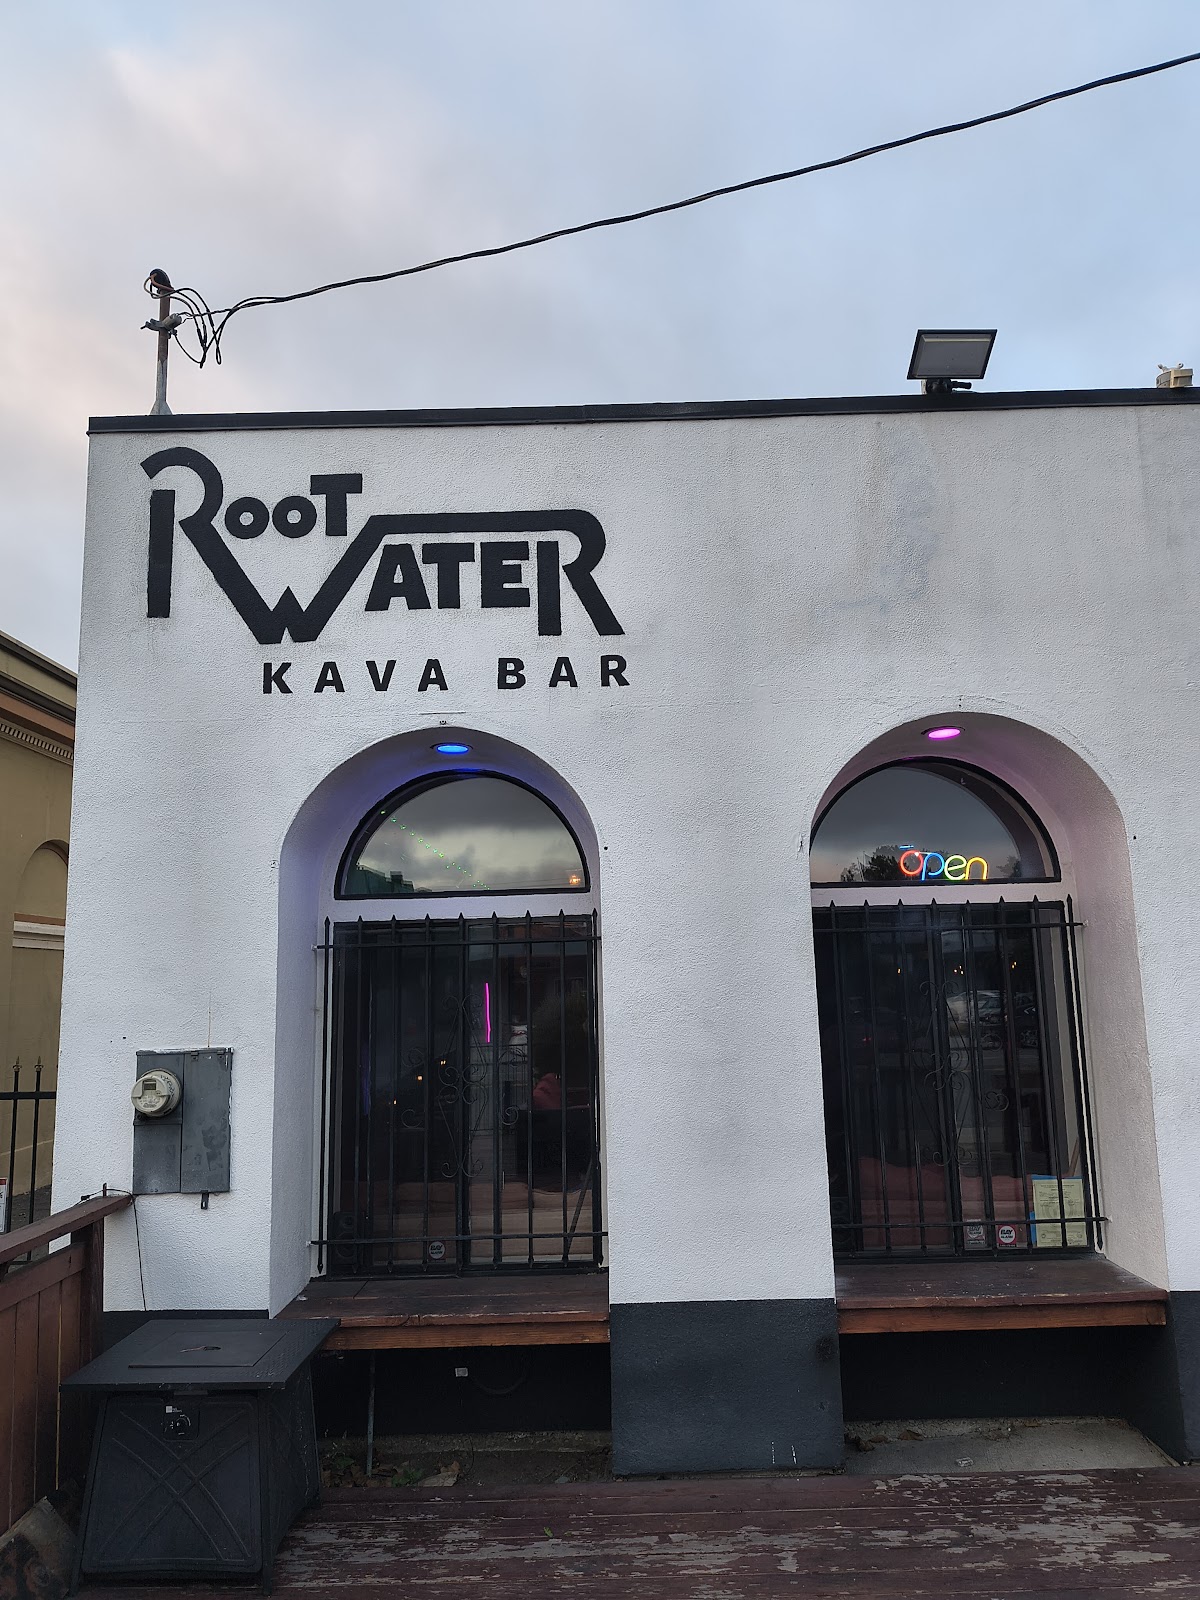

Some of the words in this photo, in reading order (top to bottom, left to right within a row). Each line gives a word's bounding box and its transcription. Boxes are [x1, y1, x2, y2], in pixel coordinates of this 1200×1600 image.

[214, 508, 626, 646] WATER
[262, 659, 449, 695] KAVA
[497, 654, 631, 690] BAR
